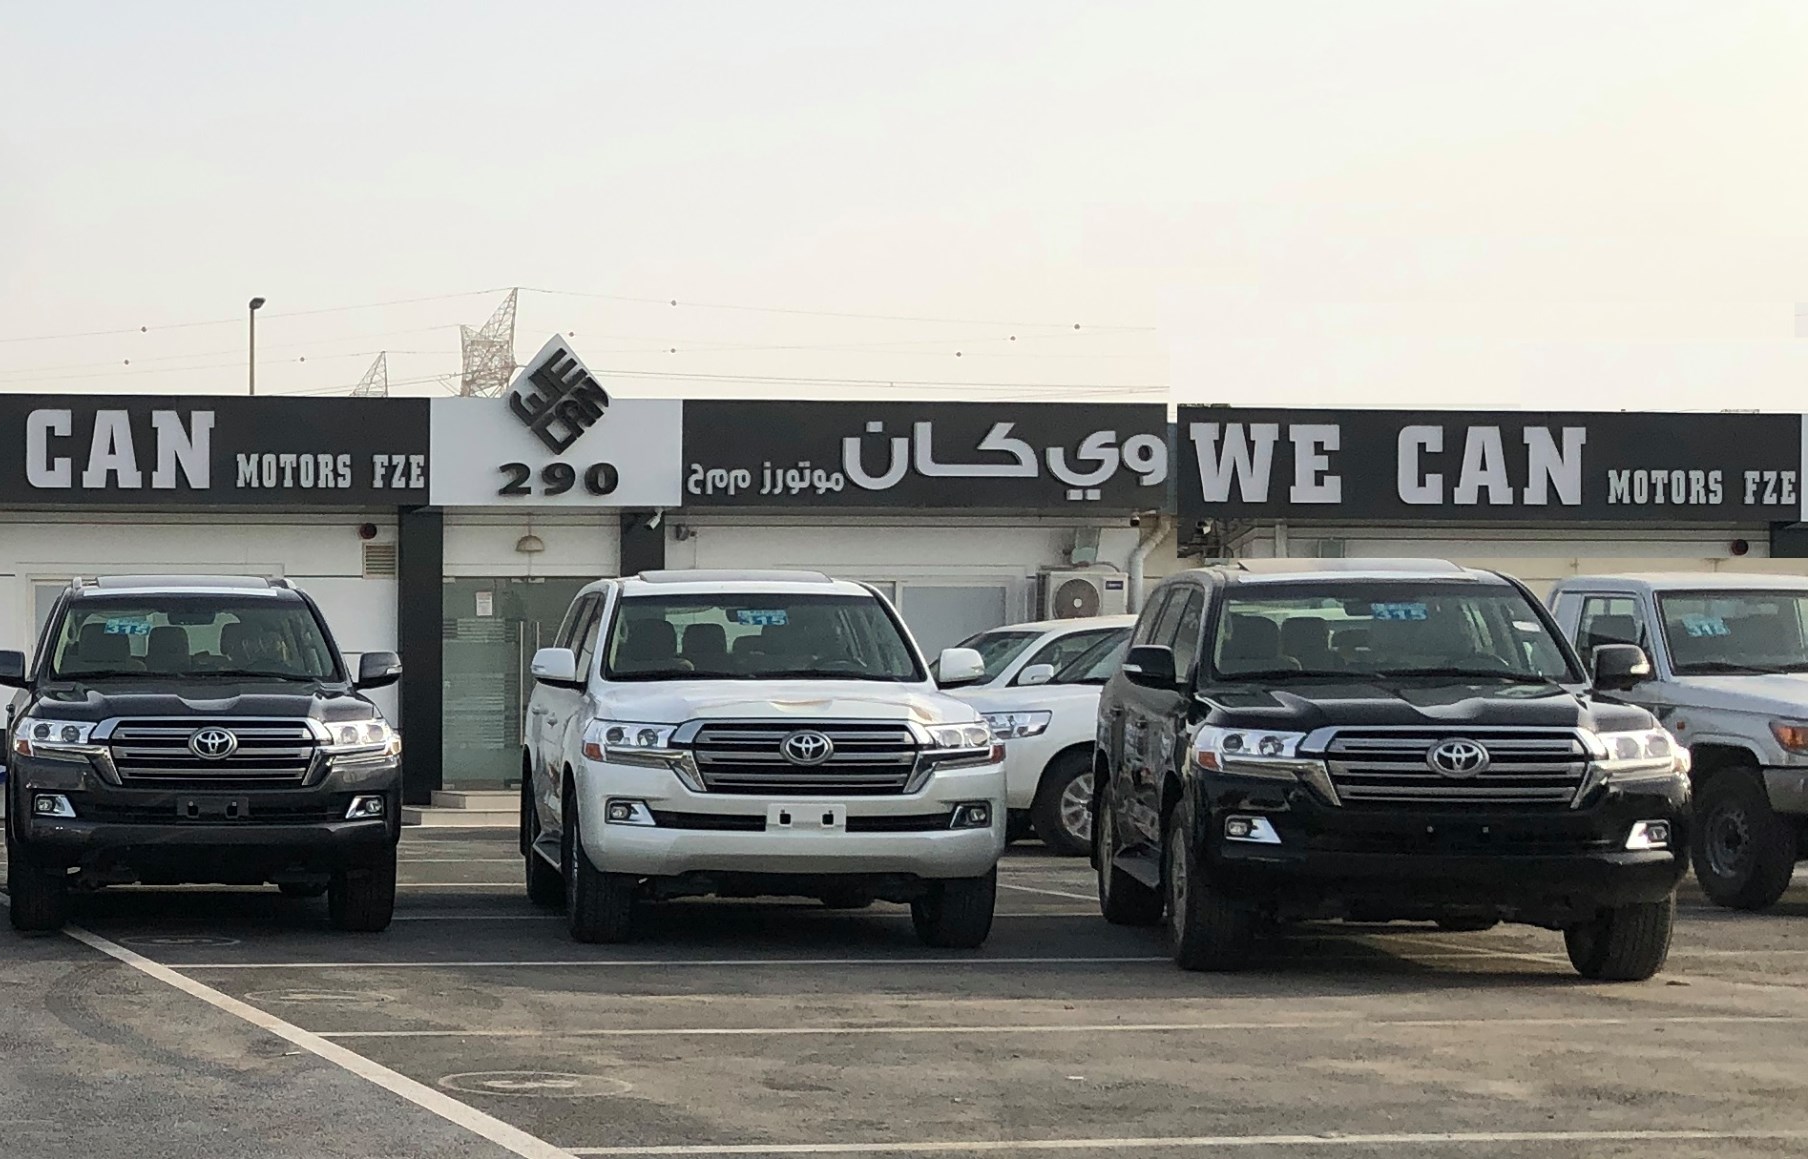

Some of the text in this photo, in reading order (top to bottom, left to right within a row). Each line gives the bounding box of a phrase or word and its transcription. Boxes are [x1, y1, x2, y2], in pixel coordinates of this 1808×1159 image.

[26, 408, 216, 490] CAN
[842, 421, 1169, 500] وي كان
[1189, 422, 1587, 506] WE CAN
[236, 452, 425, 489] MOTORS FZE
[498, 462, 620, 496] 290
[759, 460, 845, 495] موتورز
[1607, 469, 1797, 506] MOTORS FZE
